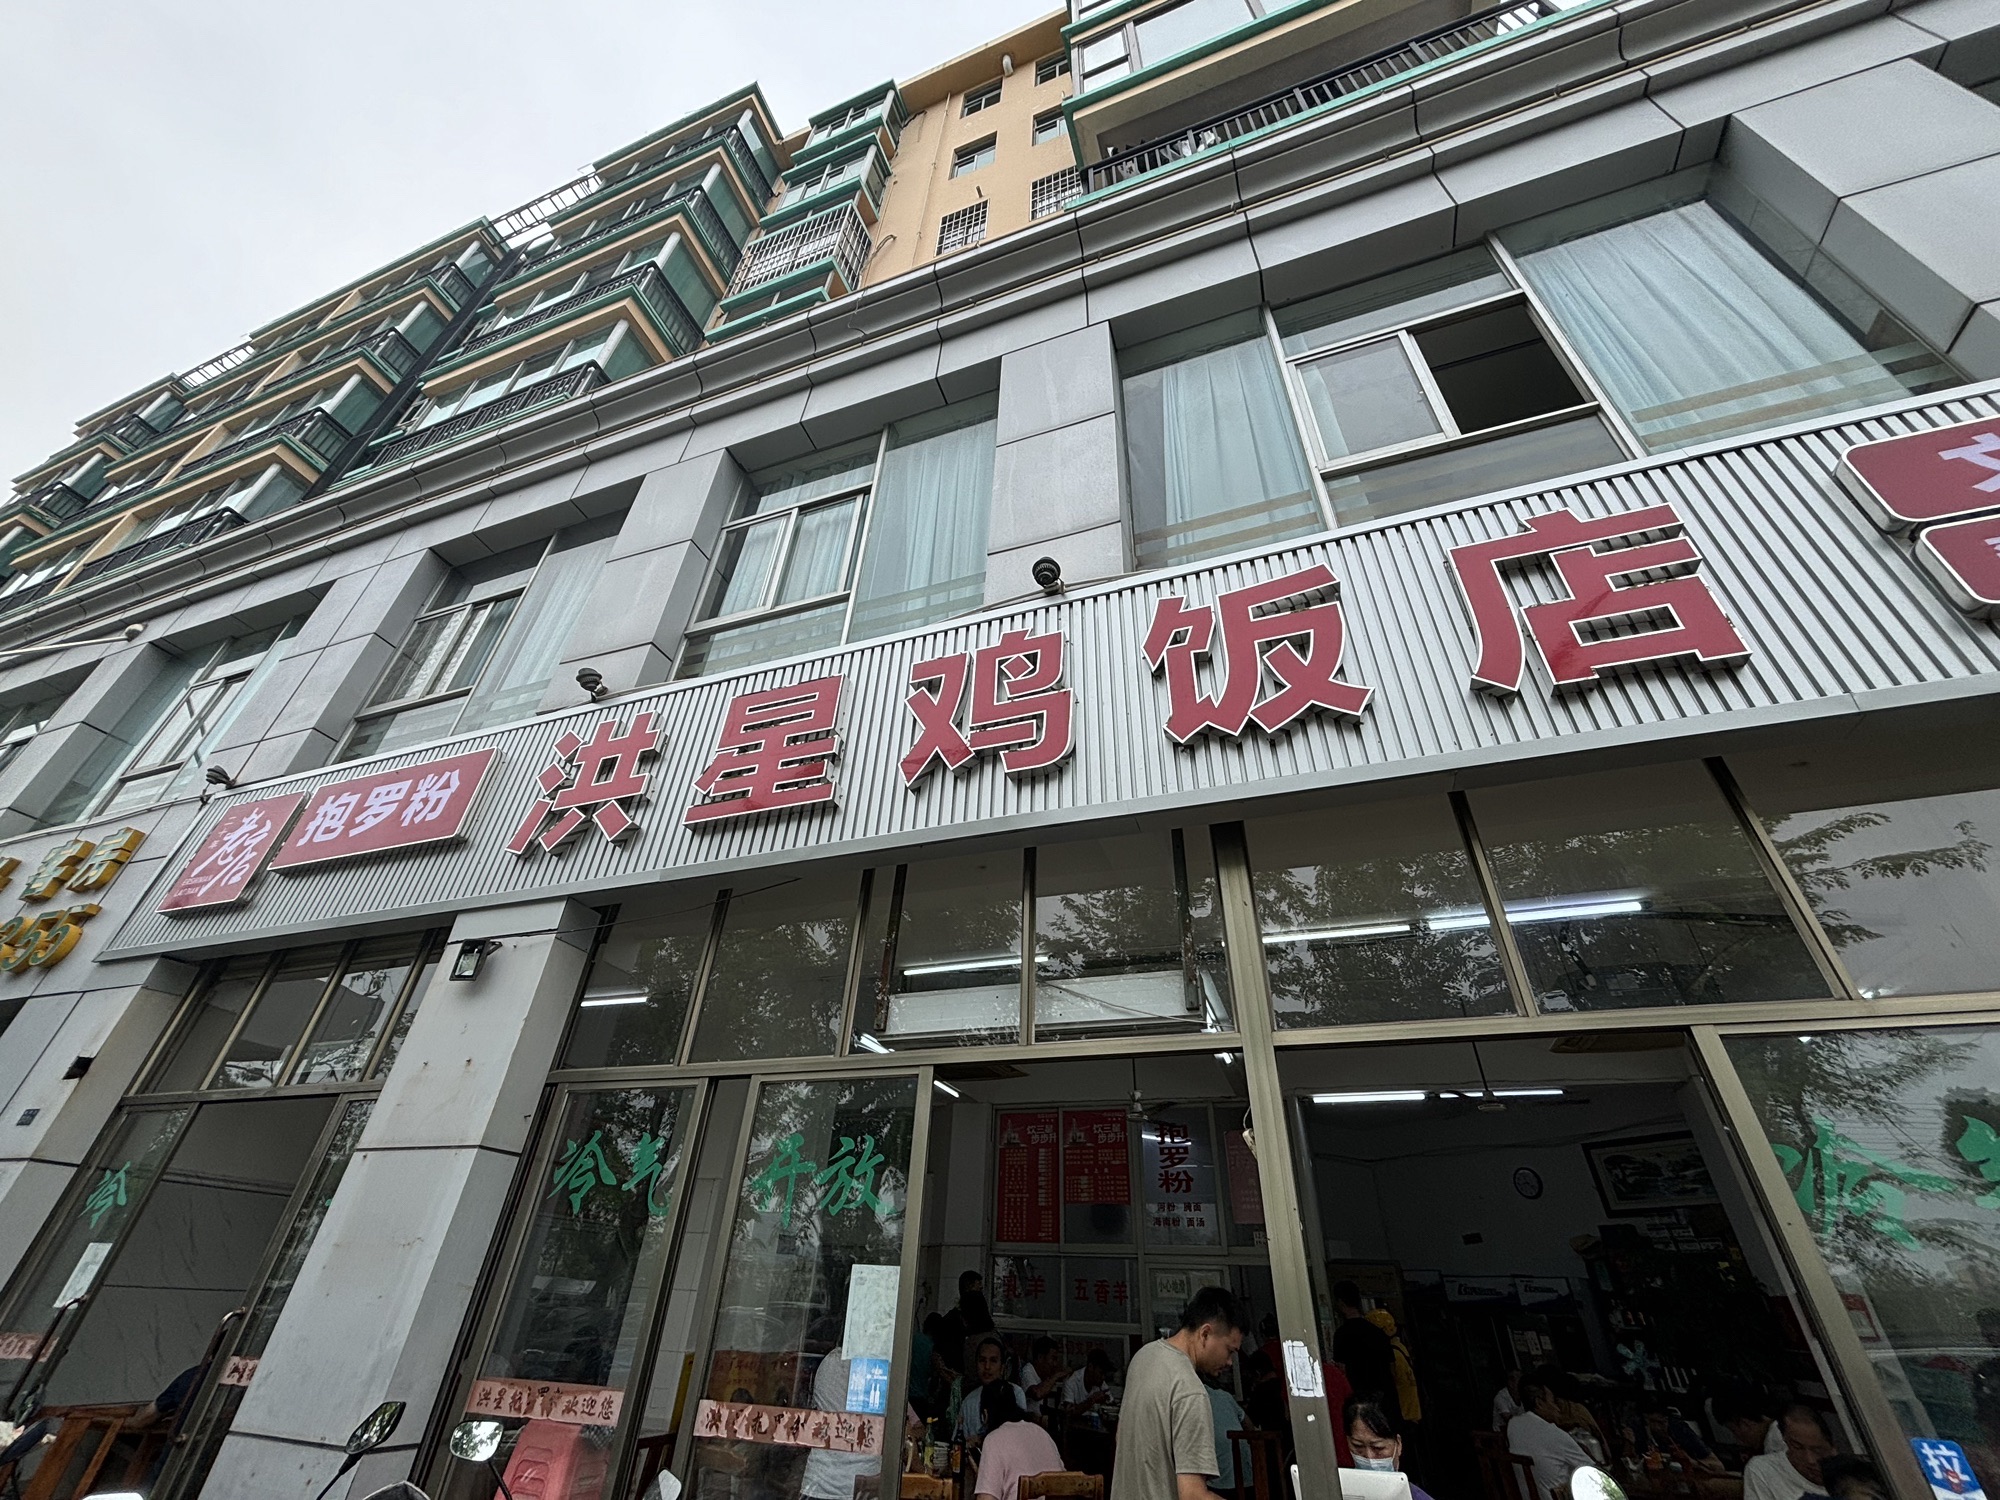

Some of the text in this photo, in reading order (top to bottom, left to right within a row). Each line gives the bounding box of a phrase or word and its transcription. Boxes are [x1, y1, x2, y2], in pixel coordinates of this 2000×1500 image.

[505, 503, 1753, 857] 洪星鸡饭店
[296, 769, 461, 847] 抱罗粉
[0, 827, 146, 903] 客房
[1155, 1121, 1194, 1194] 抱罗粉
[1074, 1277, 1129, 1306] 五香羊
[1919, 1441, 1972, 1482] 拉
